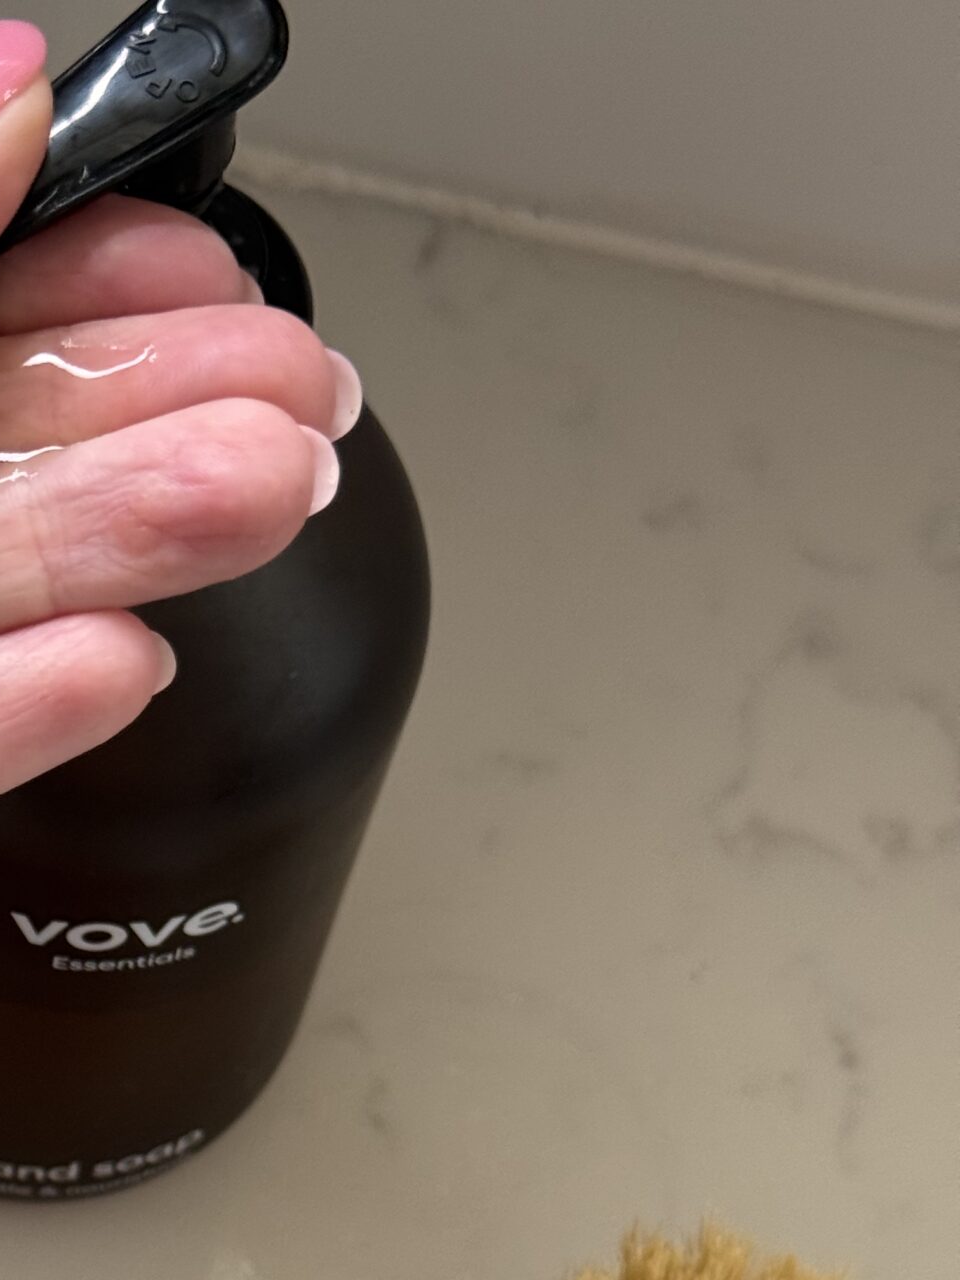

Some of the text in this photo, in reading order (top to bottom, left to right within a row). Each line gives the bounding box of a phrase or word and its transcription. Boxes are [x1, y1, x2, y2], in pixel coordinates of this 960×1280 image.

[124, 33, 200, 103] OPEN
[10, 902, 244, 951] vove.
[52, 946, 196, 972] Essentials
[93, 1129, 203, 1177] soap
